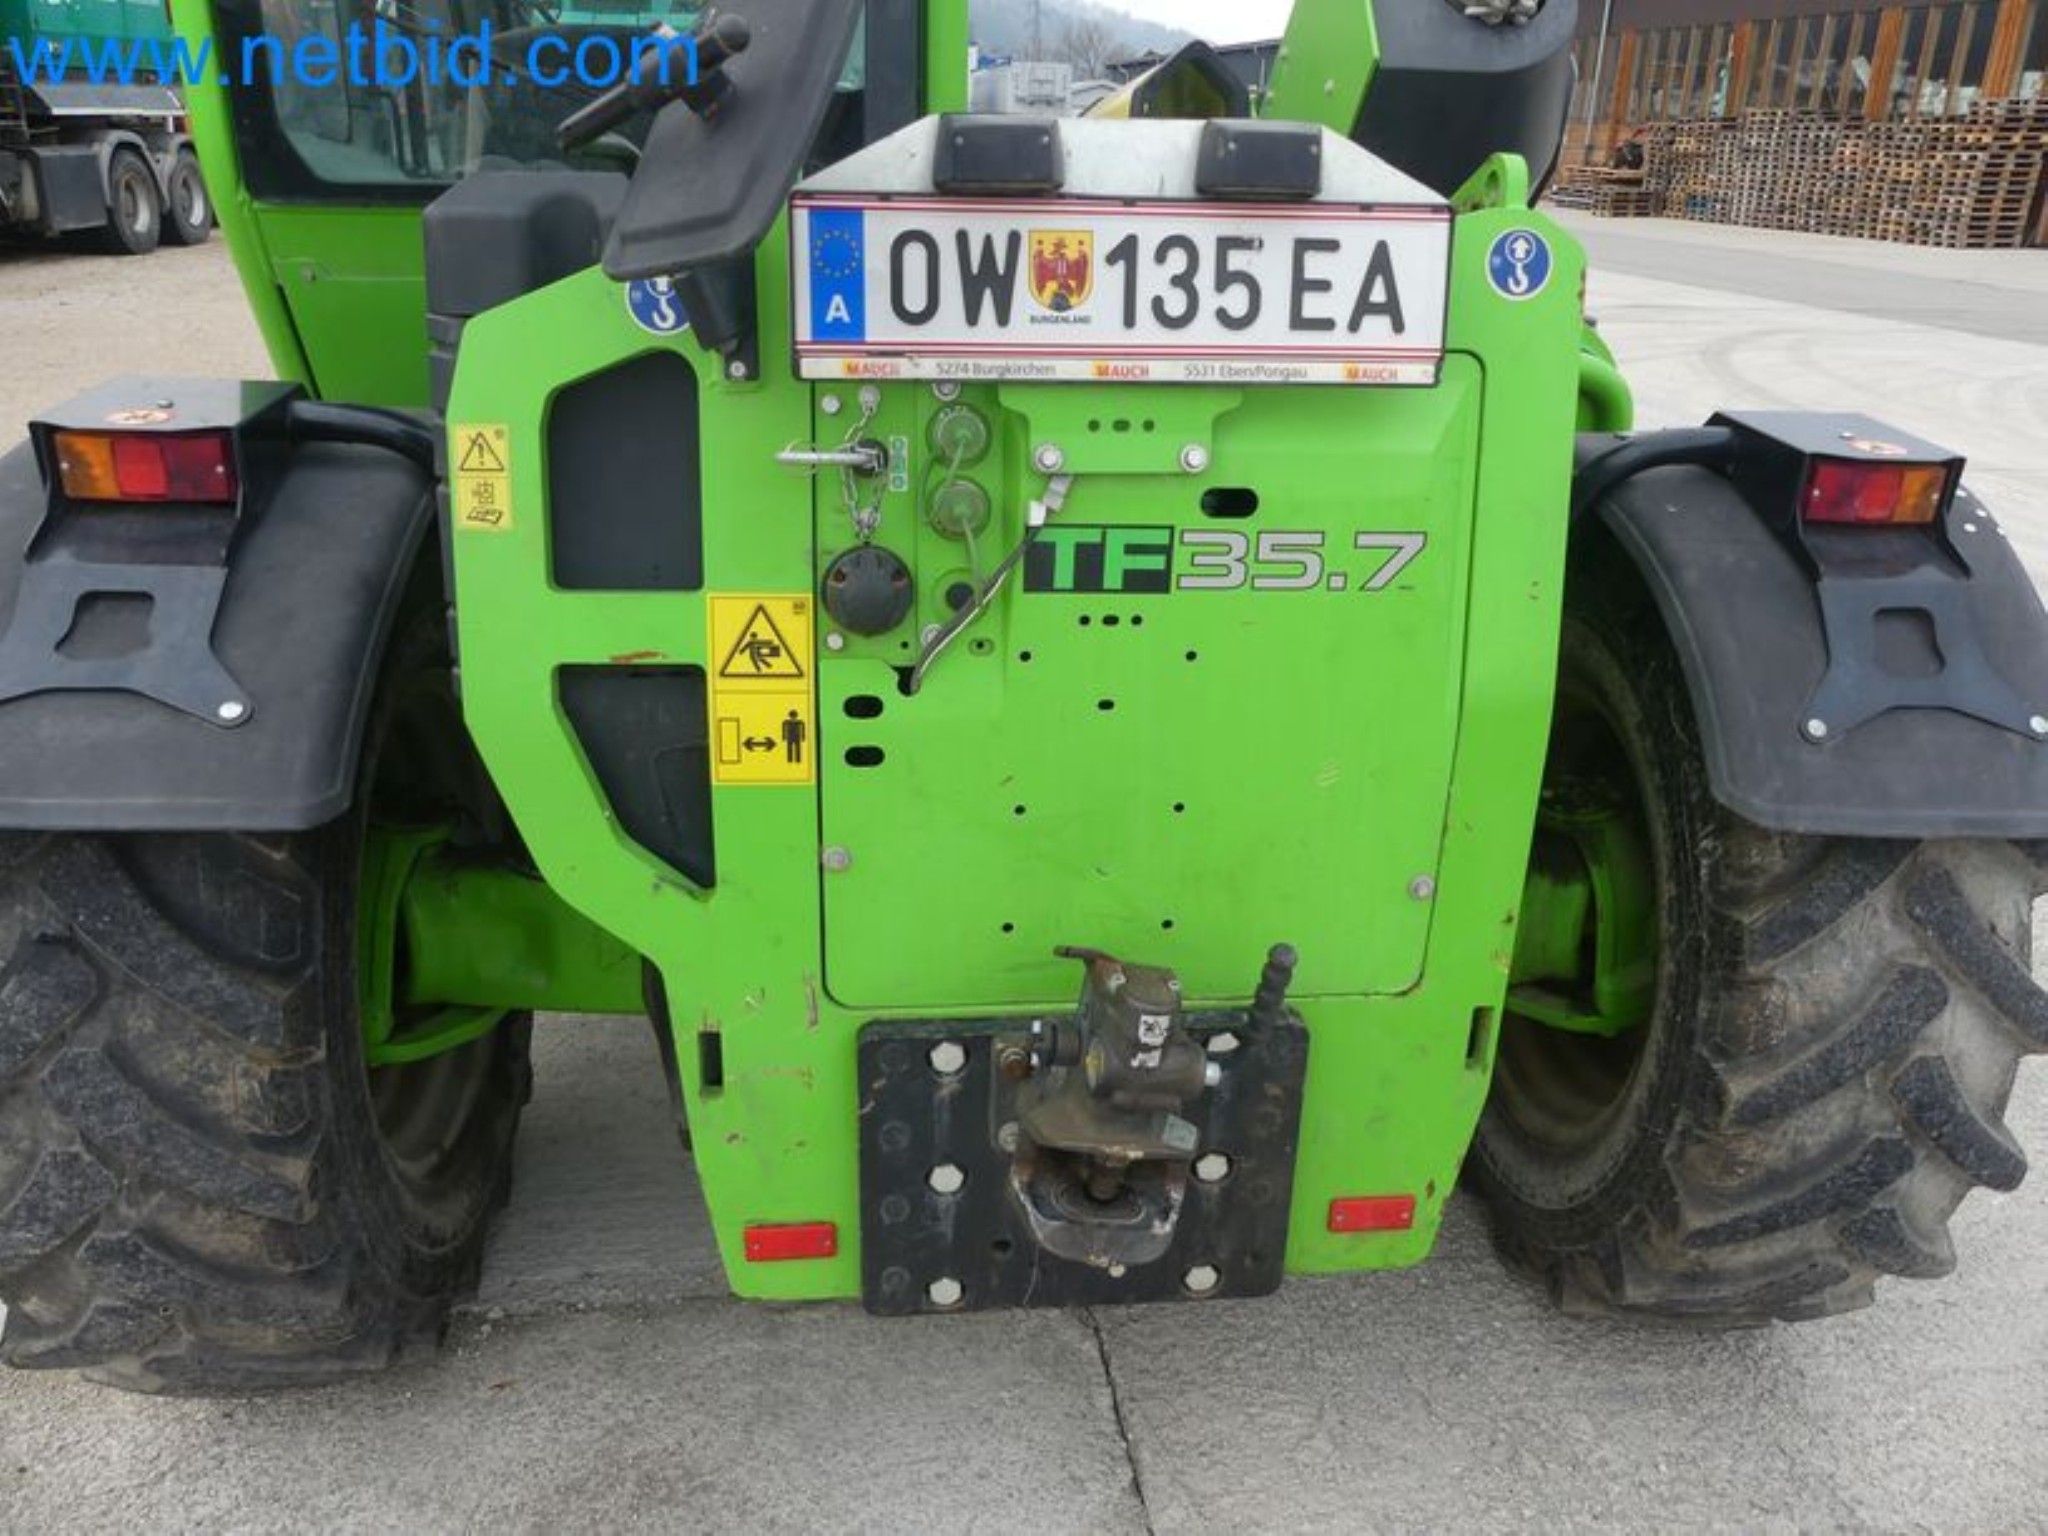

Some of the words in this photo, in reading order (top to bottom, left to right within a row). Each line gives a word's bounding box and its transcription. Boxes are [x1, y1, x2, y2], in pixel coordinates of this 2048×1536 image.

[890, 228, 1021, 327] OW
[1105, 234, 1264, 330] 135
[1289, 237, 1405, 335] EA
[825, 294, 851, 324] A
[1029, 315, 1092, 324] BURGENLAND
[845, 361, 899, 376] MAUCH
[973, 361, 1056, 379] Burgkirchen
[1094, 363, 1150, 378] MAUCH
[1220, 365, 1308, 380] Eben/Pongau
[1345, 366, 1398, 381] MAUCH
